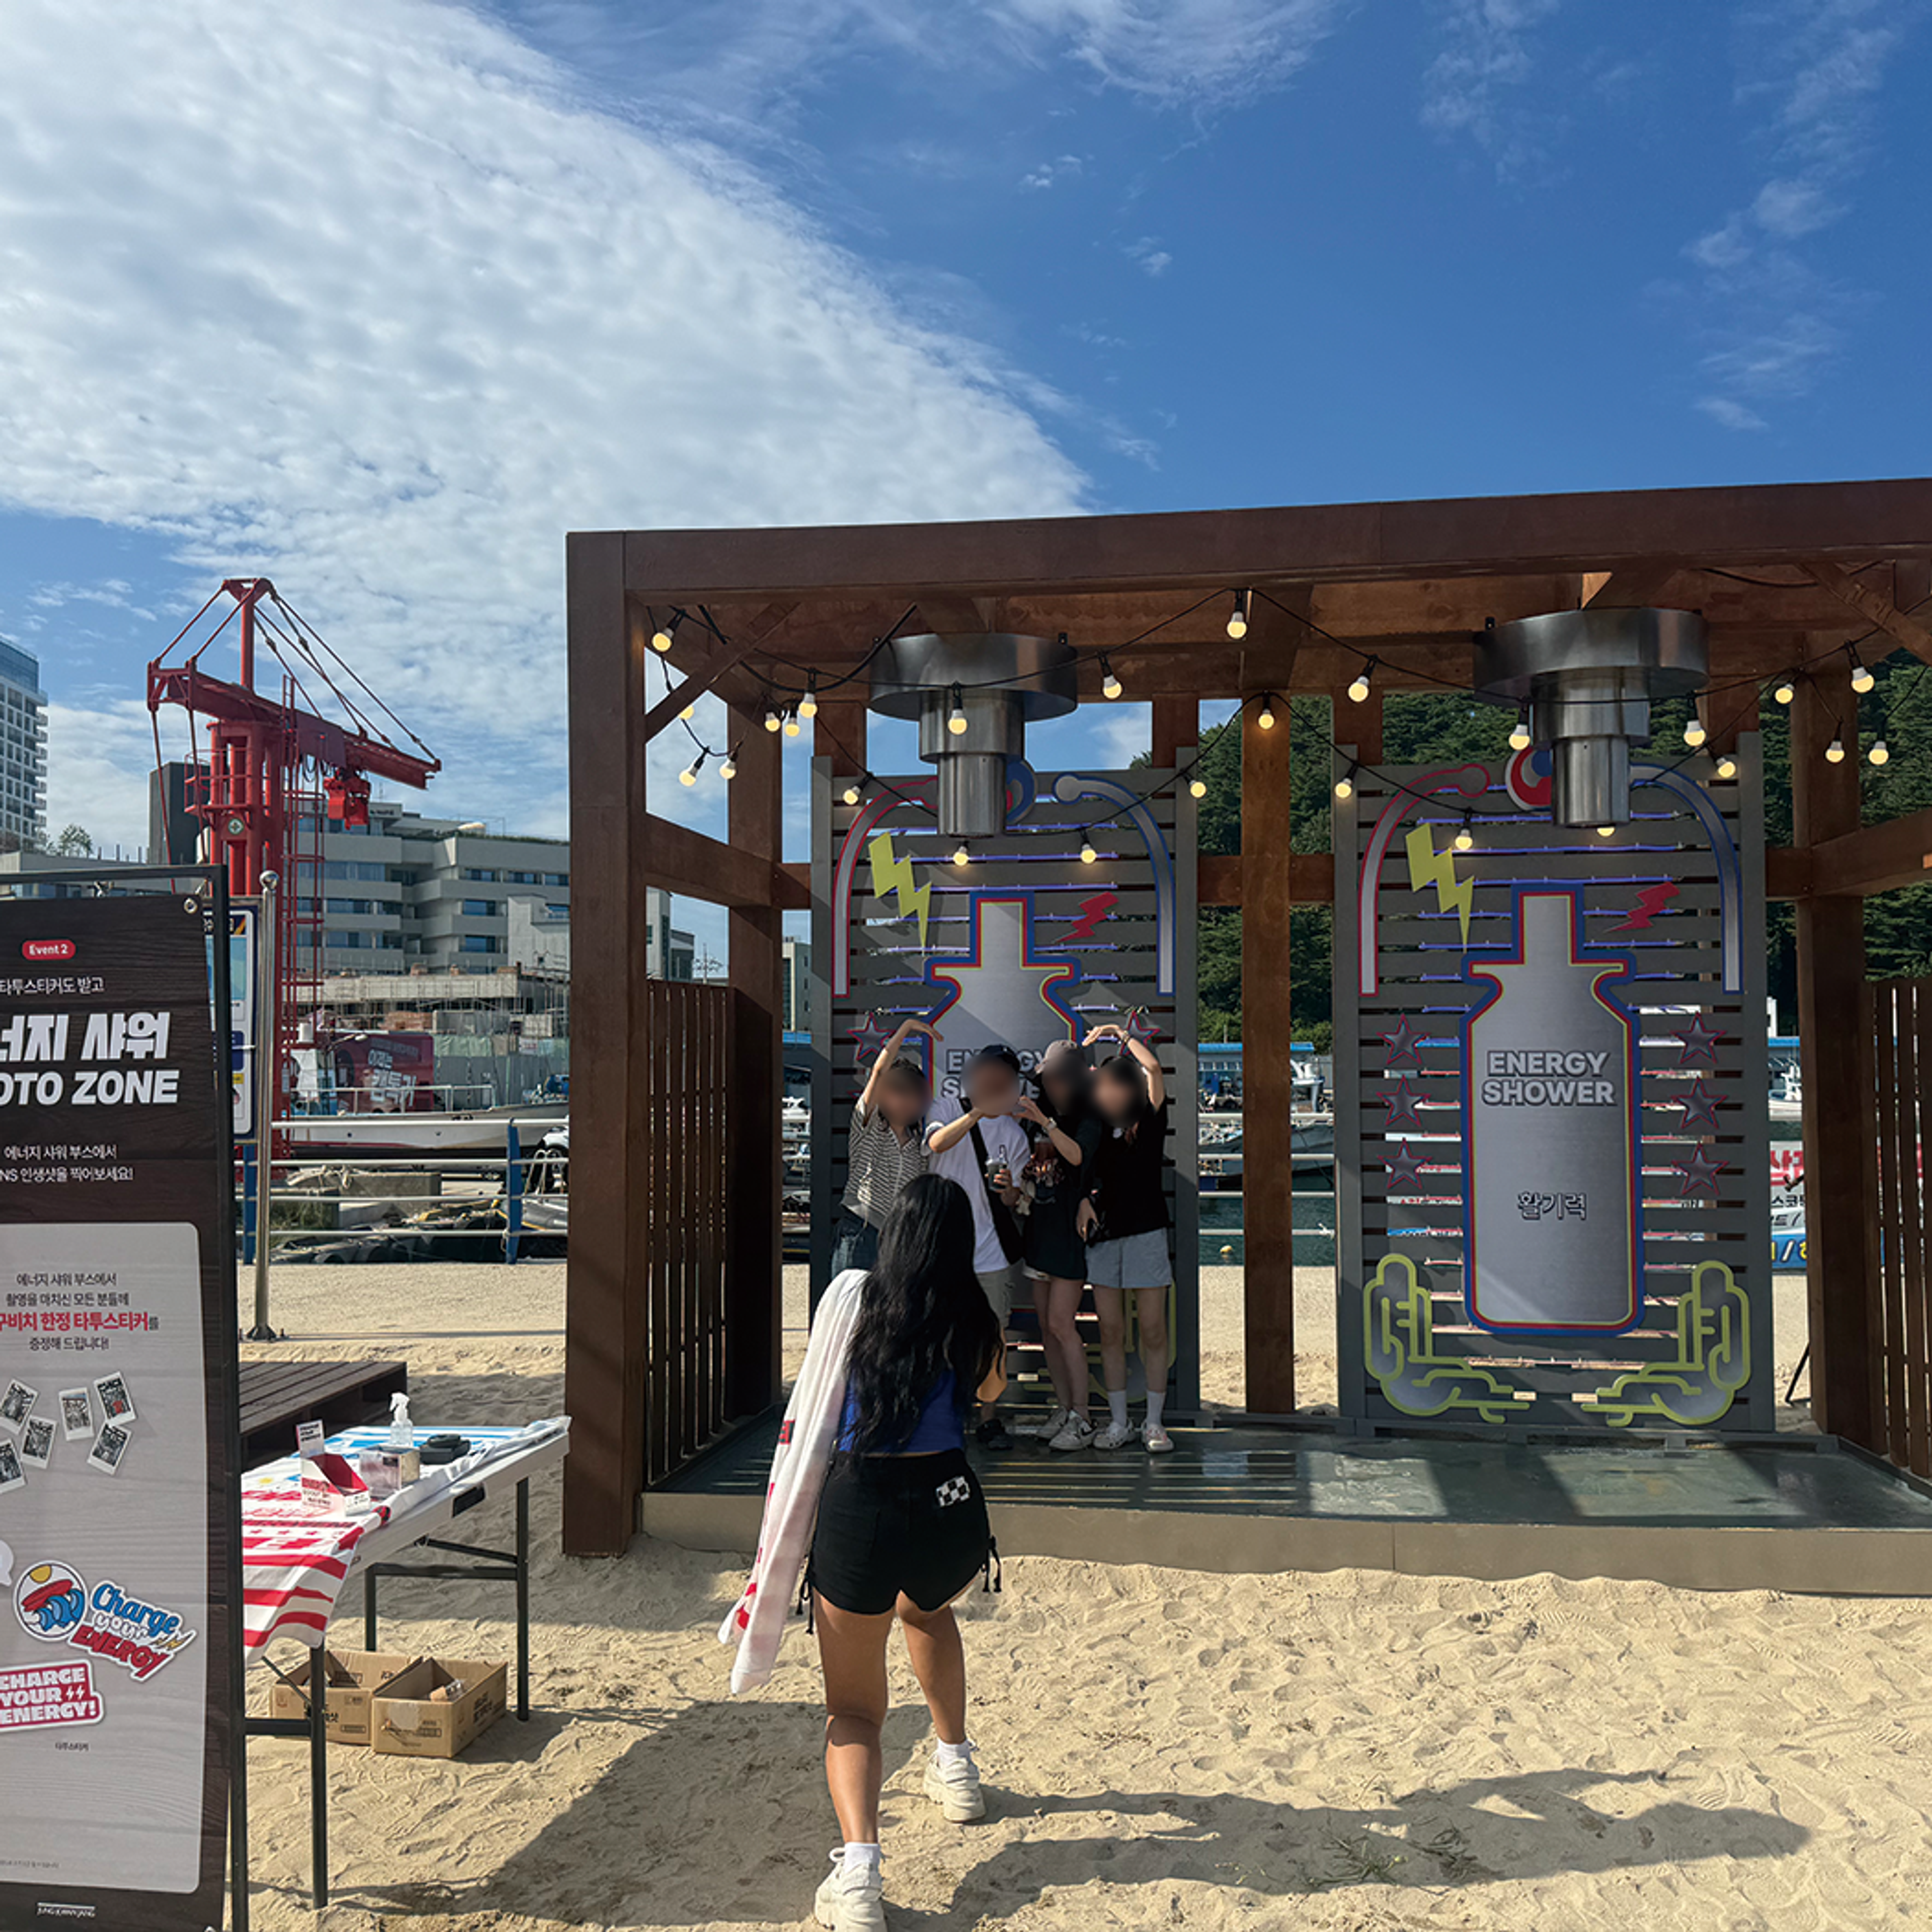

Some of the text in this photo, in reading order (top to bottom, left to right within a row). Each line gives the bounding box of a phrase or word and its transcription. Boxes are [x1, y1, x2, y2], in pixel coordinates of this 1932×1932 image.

[29, 944, 68, 955] Event 2
[0, 977, 104, 995] 타투스티커도 받고
[80, 1012, 170, 1060] 샤워
[1487, 1051, 1609, 1077] ENERGY
[71, 1070, 179, 1105] ZONE
[1482, 1080, 1616, 1105] SHOWER
[4, 1144, 117, 1160] 에너지 샤워 부스에서
[20, 1167, 66, 1182] 인생샷을
[1517, 1191, 1586, 1221] 활기력
[16, 1272, 117, 1286] 에너지 샤워 부스에서
[40, 1293, 71, 1307] 마치신
[74, 1293, 94, 1306] 모든
[40, 1312, 70, 1331] 한정
[93, 1583, 180, 1637] Charge
[96, 1613, 151, 1640] your
[70, 1624, 170, 1678] ENERGY
[0, 1686, 62, 1707] YOUR
[1, 1700, 97, 1725] ENERGY!
